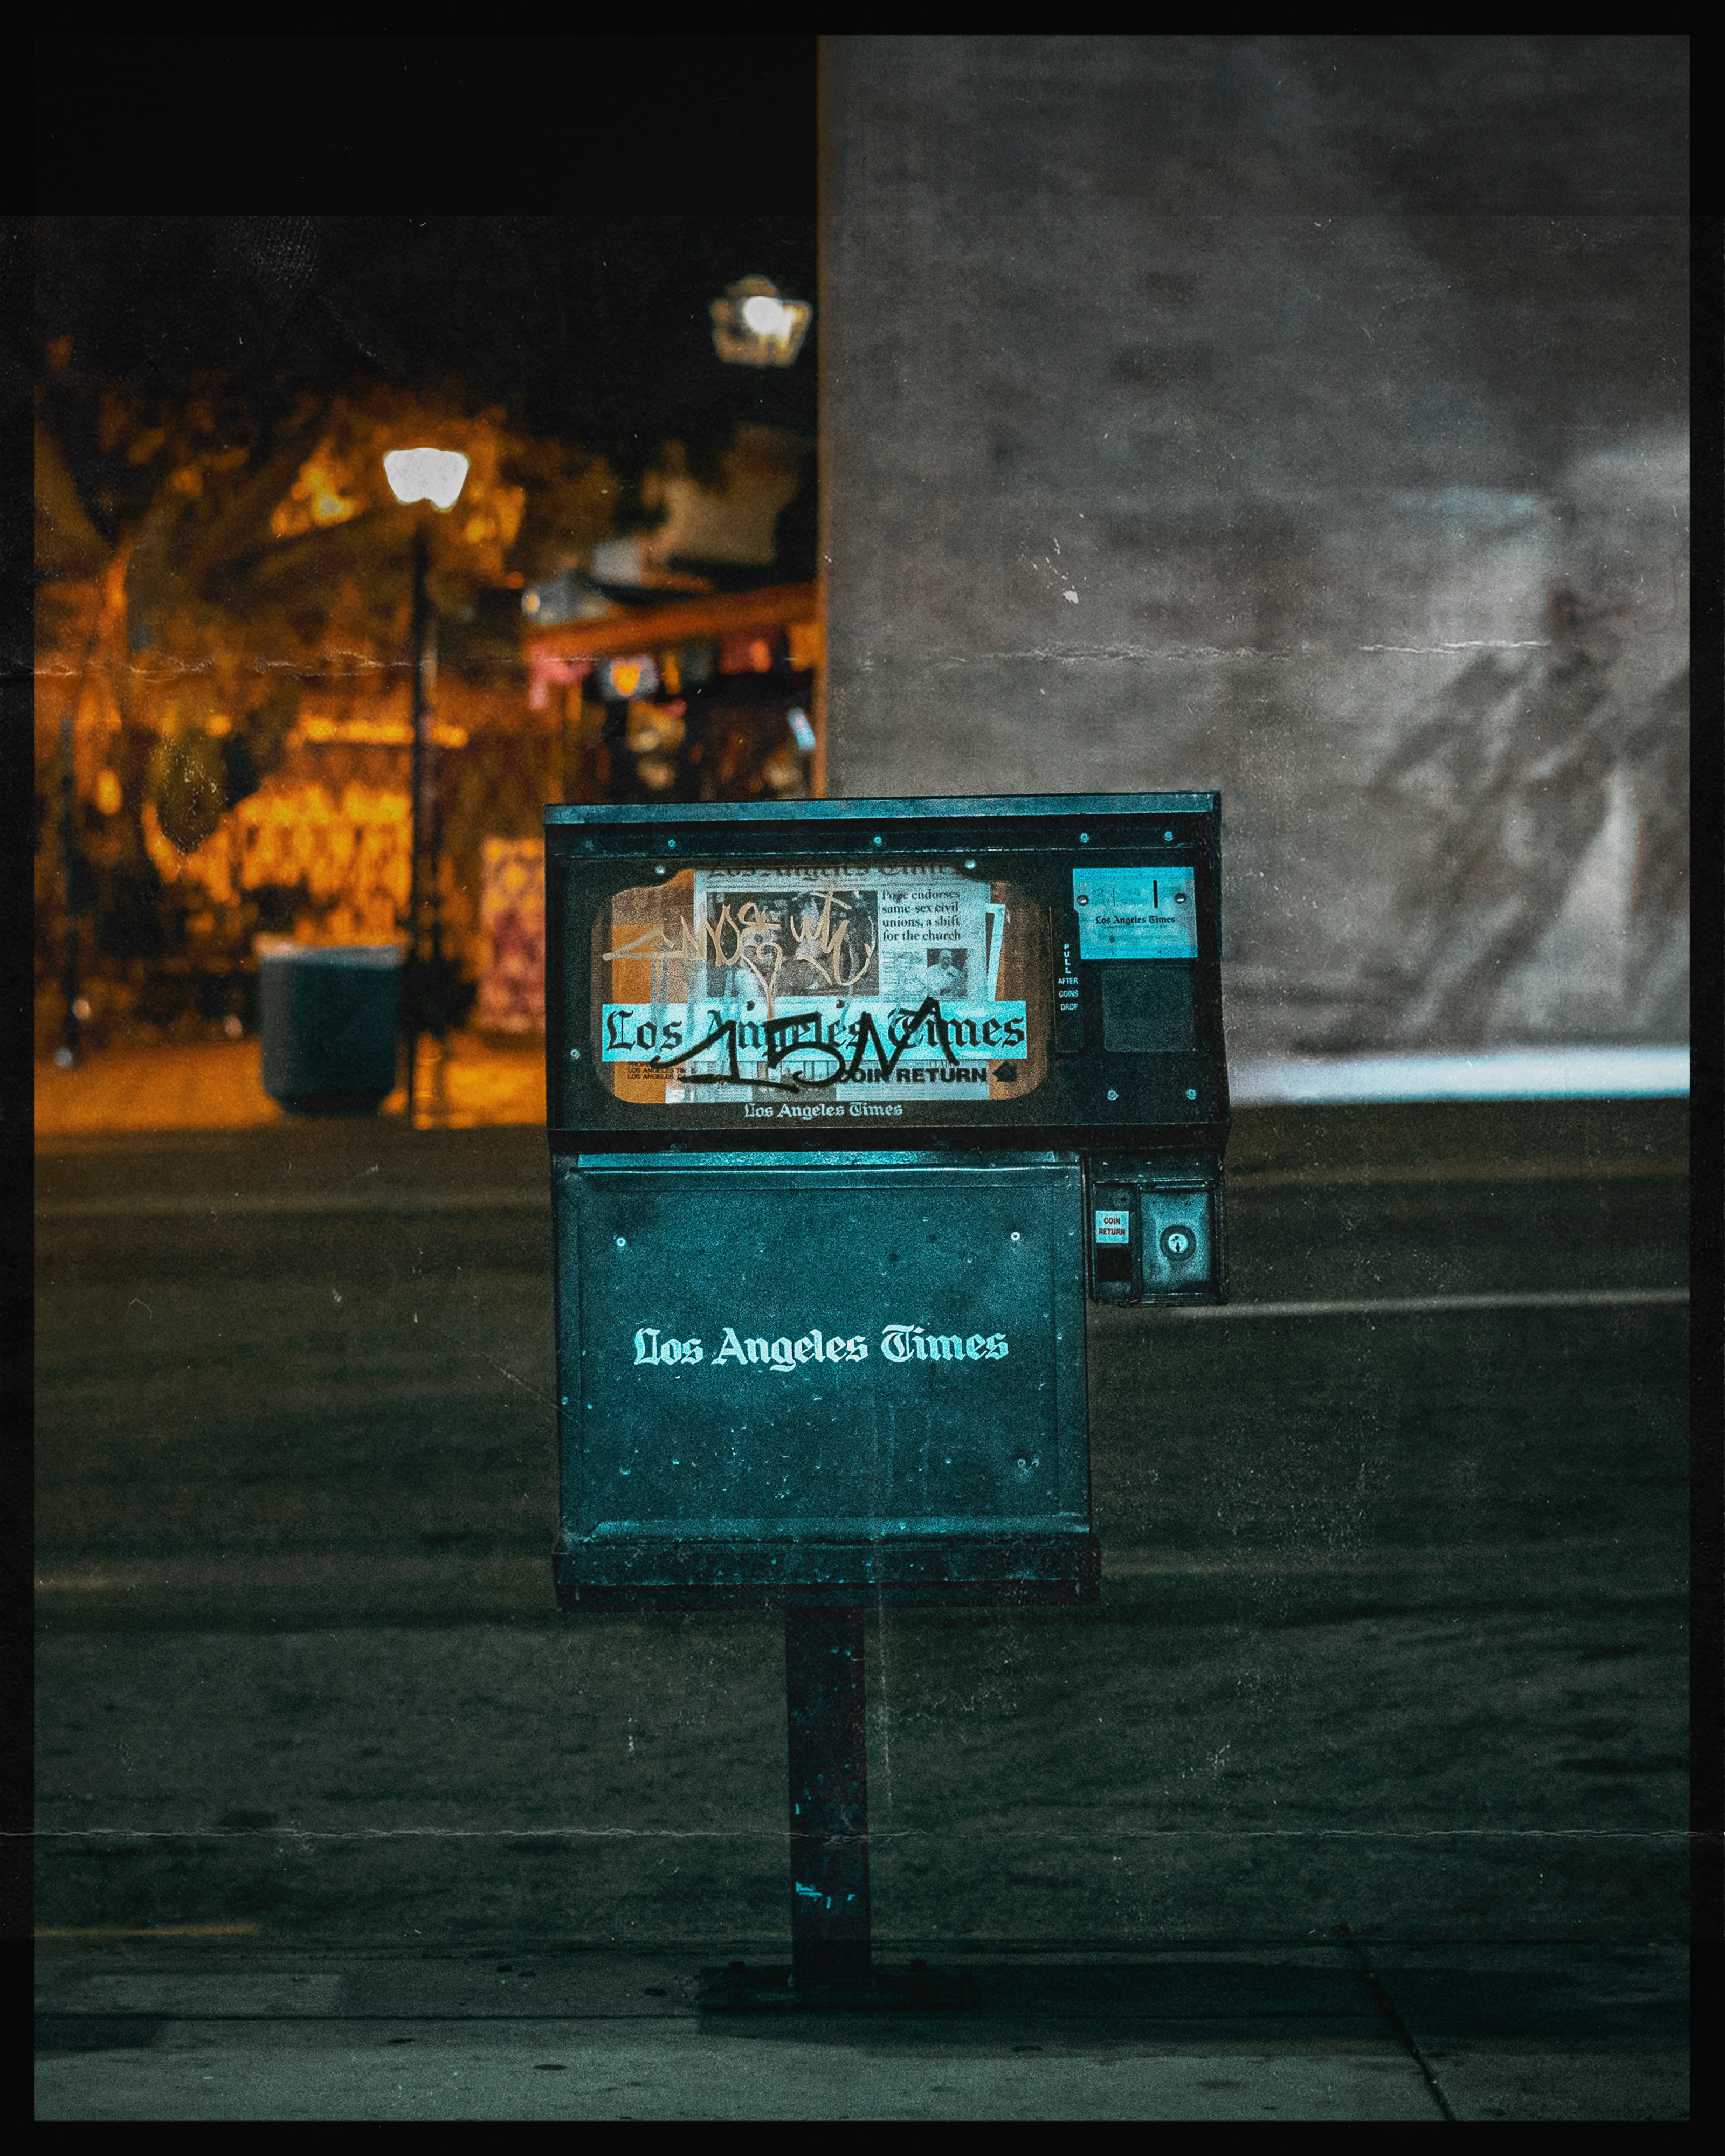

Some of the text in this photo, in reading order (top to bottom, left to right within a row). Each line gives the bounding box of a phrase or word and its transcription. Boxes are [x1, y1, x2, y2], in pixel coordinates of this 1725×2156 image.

[911, 889, 960, 899] endorses
[882, 902, 959, 914] same-sex civil
[882, 916, 924, 928] unions,
[935, 915, 960, 927] shift
[1095, 915, 1176, 925] Los Angeles Times
[882, 929, 961, 941] for the church
[1064, 943, 1072, 974] PULL
[1058, 990, 1079, 998] COINS
[606, 1010, 682, 1051] Los
[888, 1007, 1025, 1048] Times
[896, 1067, 987, 1083] RETURN
[744, 1102, 903, 1120] Los Angeles Times
[634, 1324, 1009, 1372] Los Angeles Times
